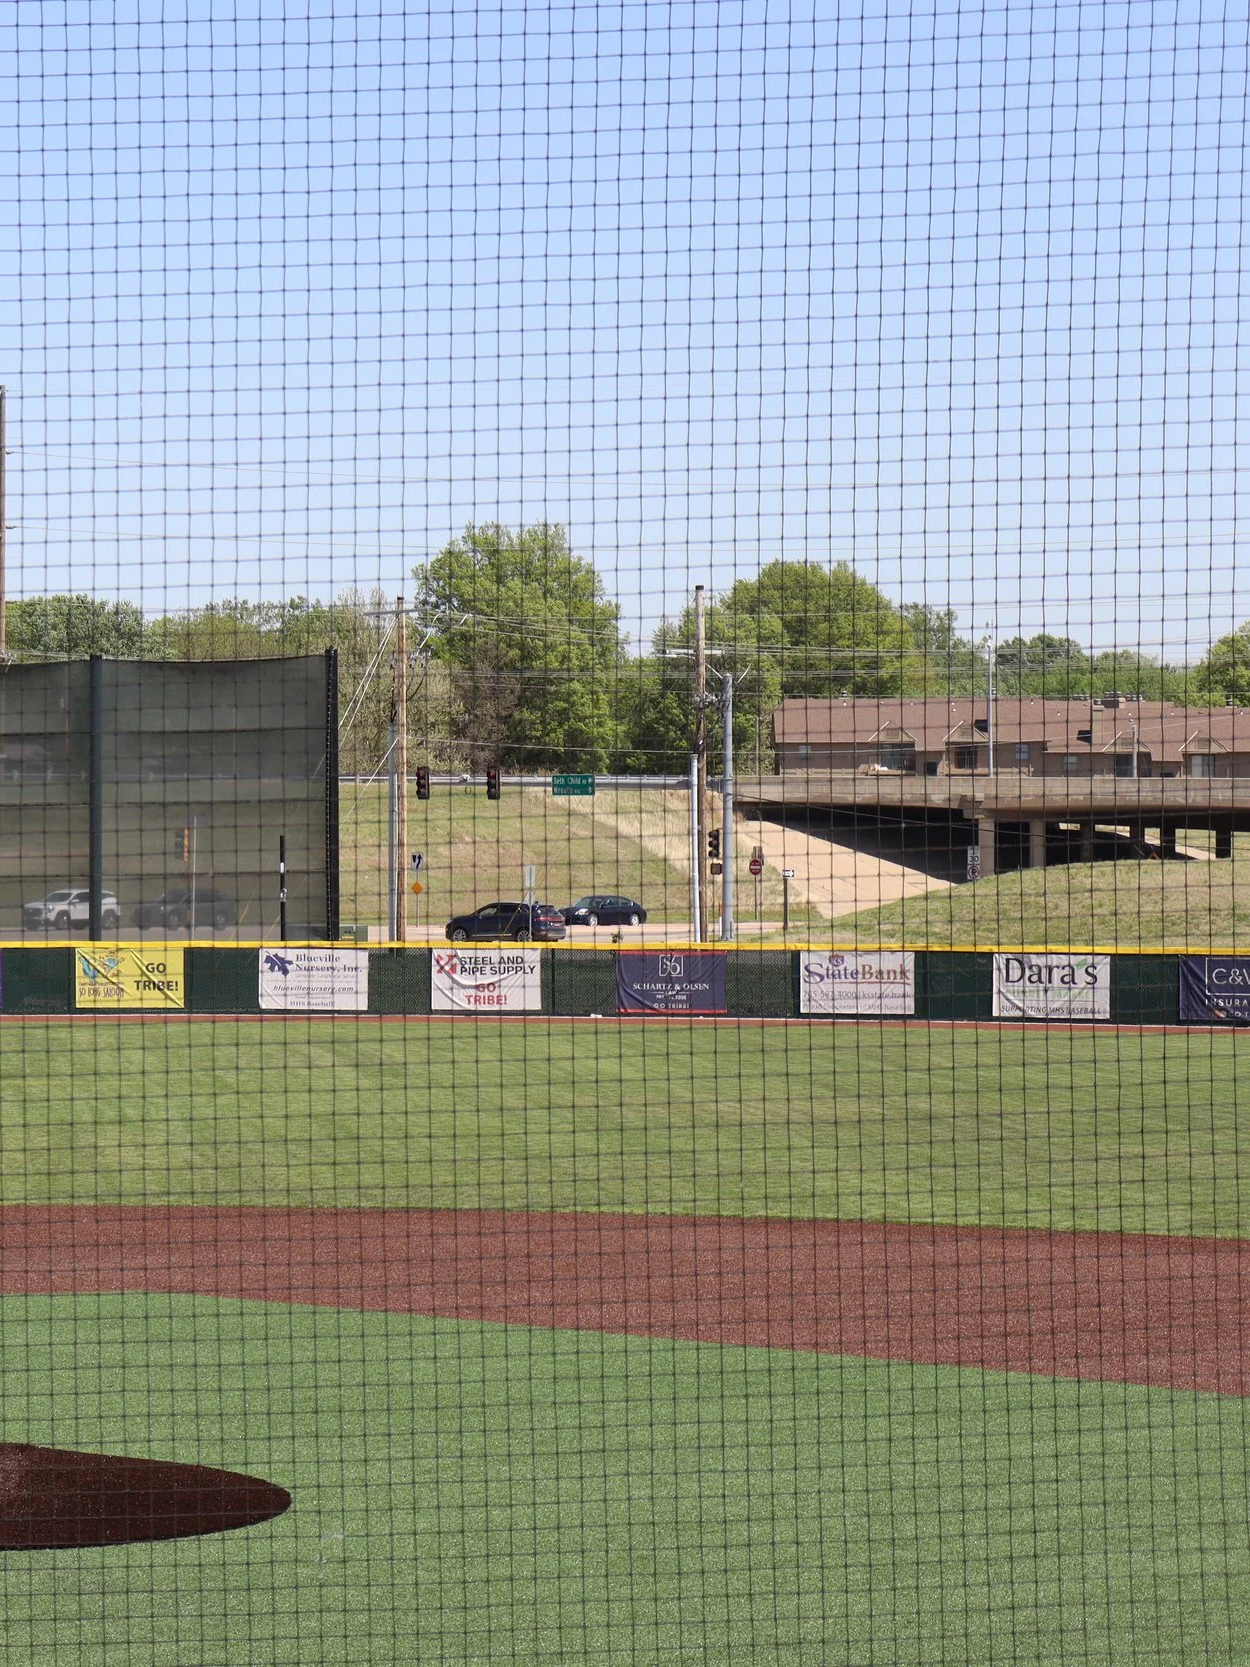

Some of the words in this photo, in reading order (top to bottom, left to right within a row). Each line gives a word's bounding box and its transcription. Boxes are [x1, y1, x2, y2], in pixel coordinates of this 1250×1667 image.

[296, 954, 340, 962] Blueville
[460, 956, 494, 966] STEEL
[498, 956, 524, 965] AND
[146, 962, 166, 974] GO
[296, 964, 340, 973] Nursery,
[343, 964, 362, 973] Inc.
[460, 966, 486, 976] PIPE
[490, 966, 536, 975] SUPPLY
[1006, 958, 1098, 985] Dara's
[1212, 968, 1250, 986] C&
[134, 980, 178, 991] TRIBE!
[477, 983, 496, 992] GO
[465, 994, 507, 1005] TRIBE!
[1066, 1006, 1102, 1014] BASEBALL
